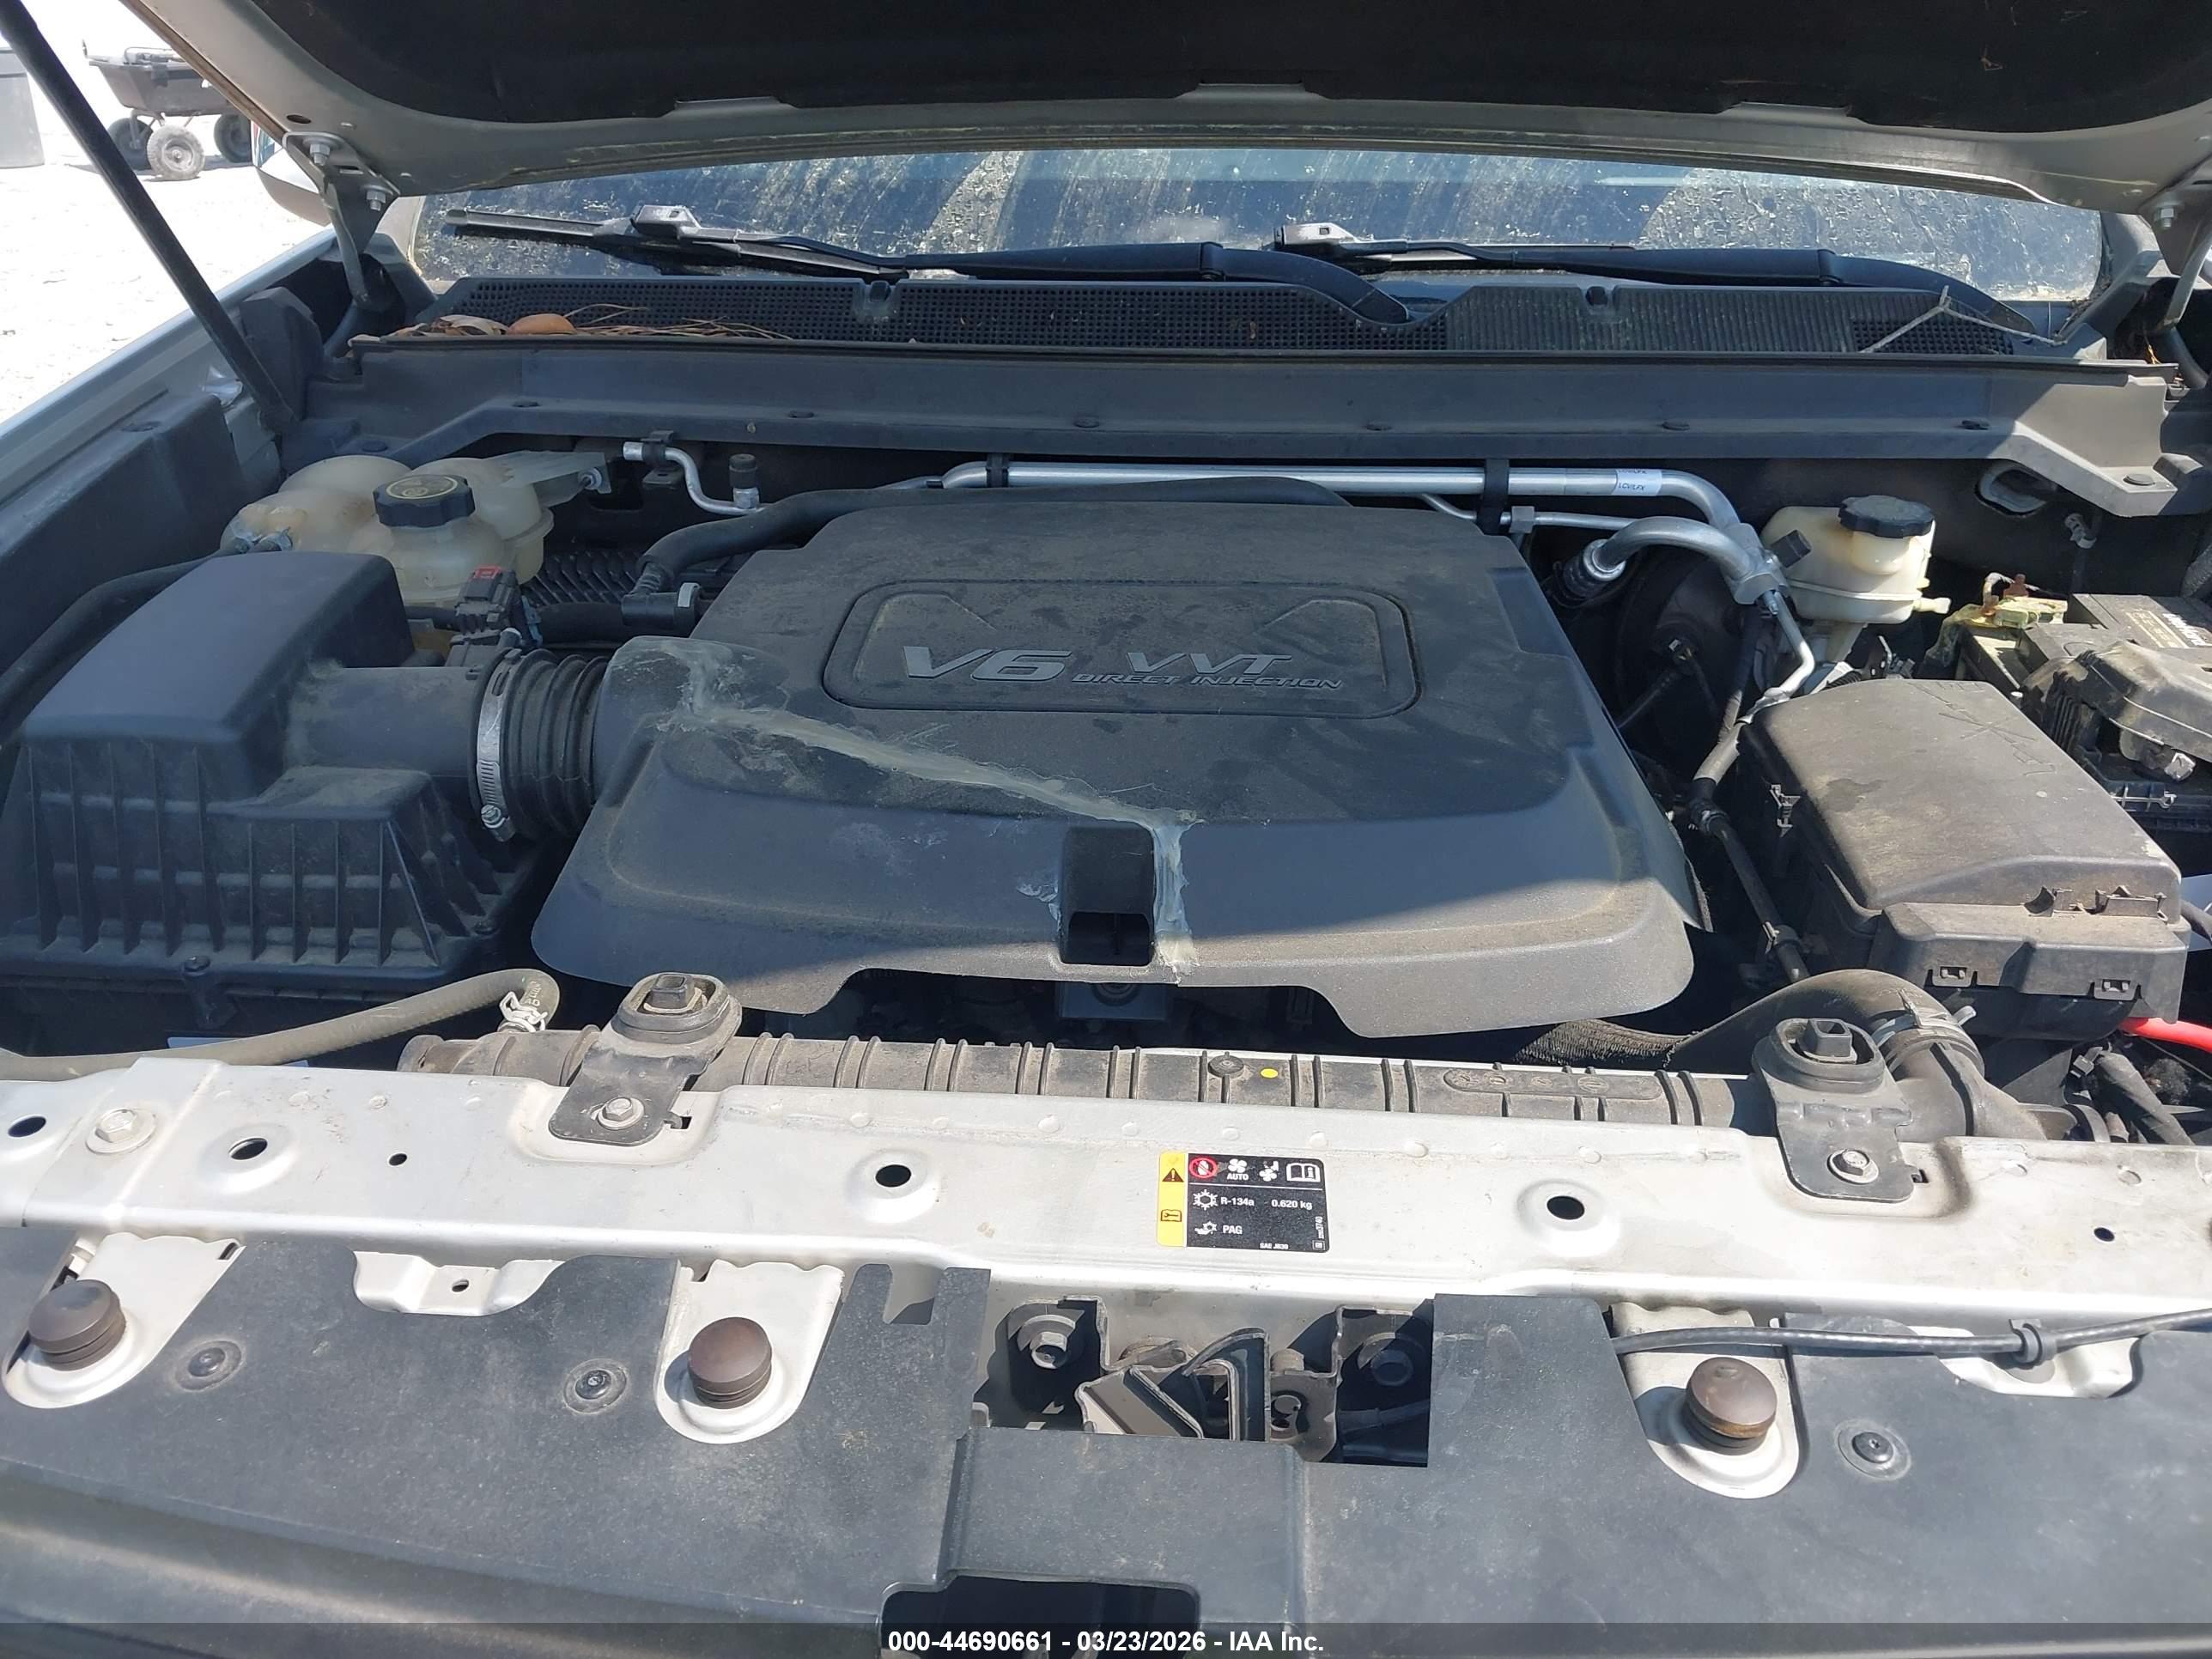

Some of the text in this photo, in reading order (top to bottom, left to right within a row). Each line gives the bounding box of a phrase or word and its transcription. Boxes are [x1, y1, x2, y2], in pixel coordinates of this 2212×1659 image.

[903, 646, 1292, 682] V6 VVT
[1072, 673, 1342, 689] DIRECT INJECTION
[1220, 1196, 1313, 1211] R-134a 0.620 kg
[1222, 1224, 1243, 1235] PAG
